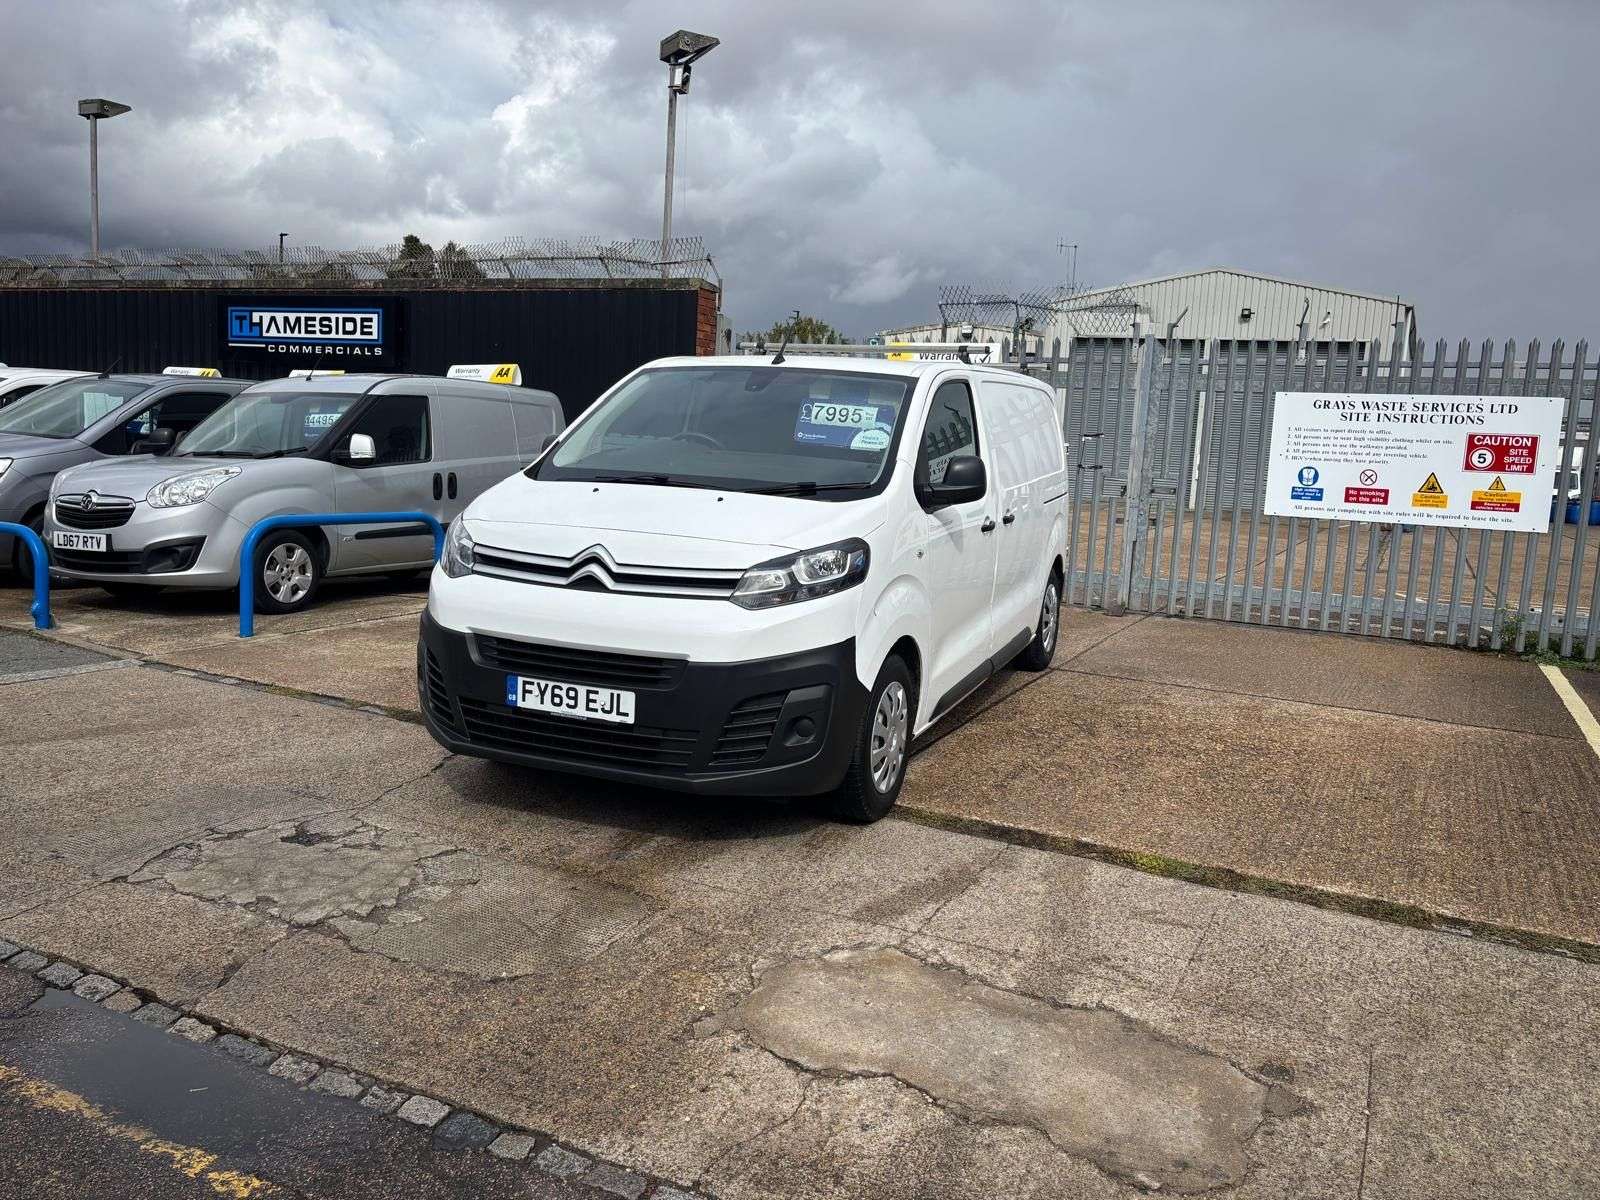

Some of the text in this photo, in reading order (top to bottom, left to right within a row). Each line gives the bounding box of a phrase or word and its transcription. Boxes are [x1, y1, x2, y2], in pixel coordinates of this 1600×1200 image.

[234, 315, 374, 336] THAMESIDE
[268, 344, 382, 356] COMMERCIALS
[496, 368, 510, 378] AA
[1313, 400, 1519, 414] GRAYS WASTE SERVICES LTD
[1340, 412, 1485, 426] SITE INSTRUCTIONS
[1474, 436, 1532, 447] CAUTION
[1478, 453, 1487, 464] 5
[57, 534, 102, 549] LD67 RTV
[522, 680, 629, 717] FY69 EJL
